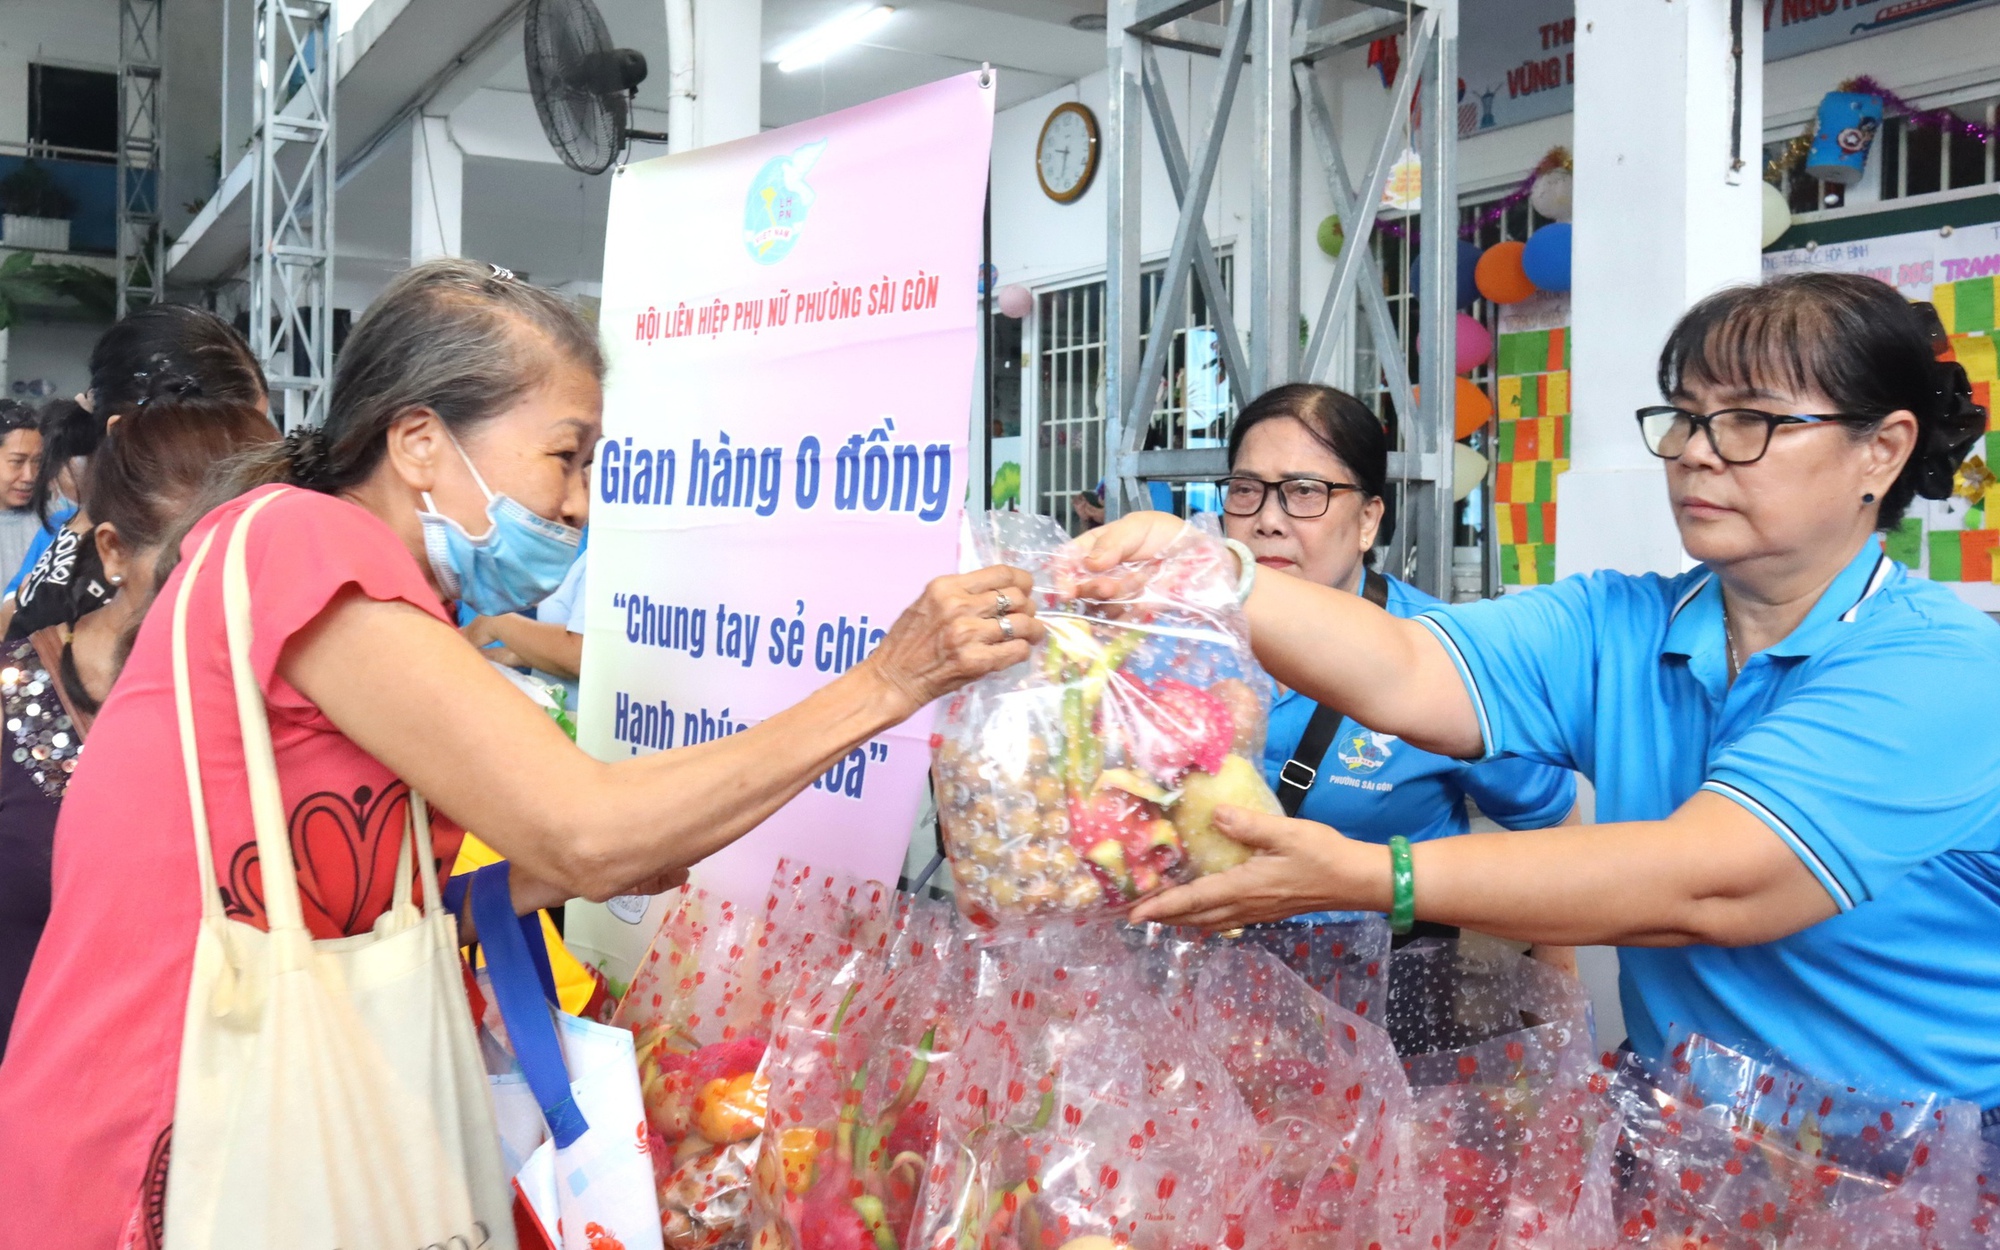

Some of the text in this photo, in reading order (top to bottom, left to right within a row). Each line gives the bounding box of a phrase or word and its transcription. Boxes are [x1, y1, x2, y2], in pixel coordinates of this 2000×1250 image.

[636, 270, 939, 346] HỘI LIÊN HIỆP PHỤ NỮ PHƯỜNG SÀI GÒN
[600, 437, 676, 506] Gian
[686, 429, 783, 517] hàng
[834, 417, 950, 522] đồng
[716, 603, 761, 667] tay
[768, 600, 805, 667] sẻ
[614, 691, 675, 755] Hạnh
